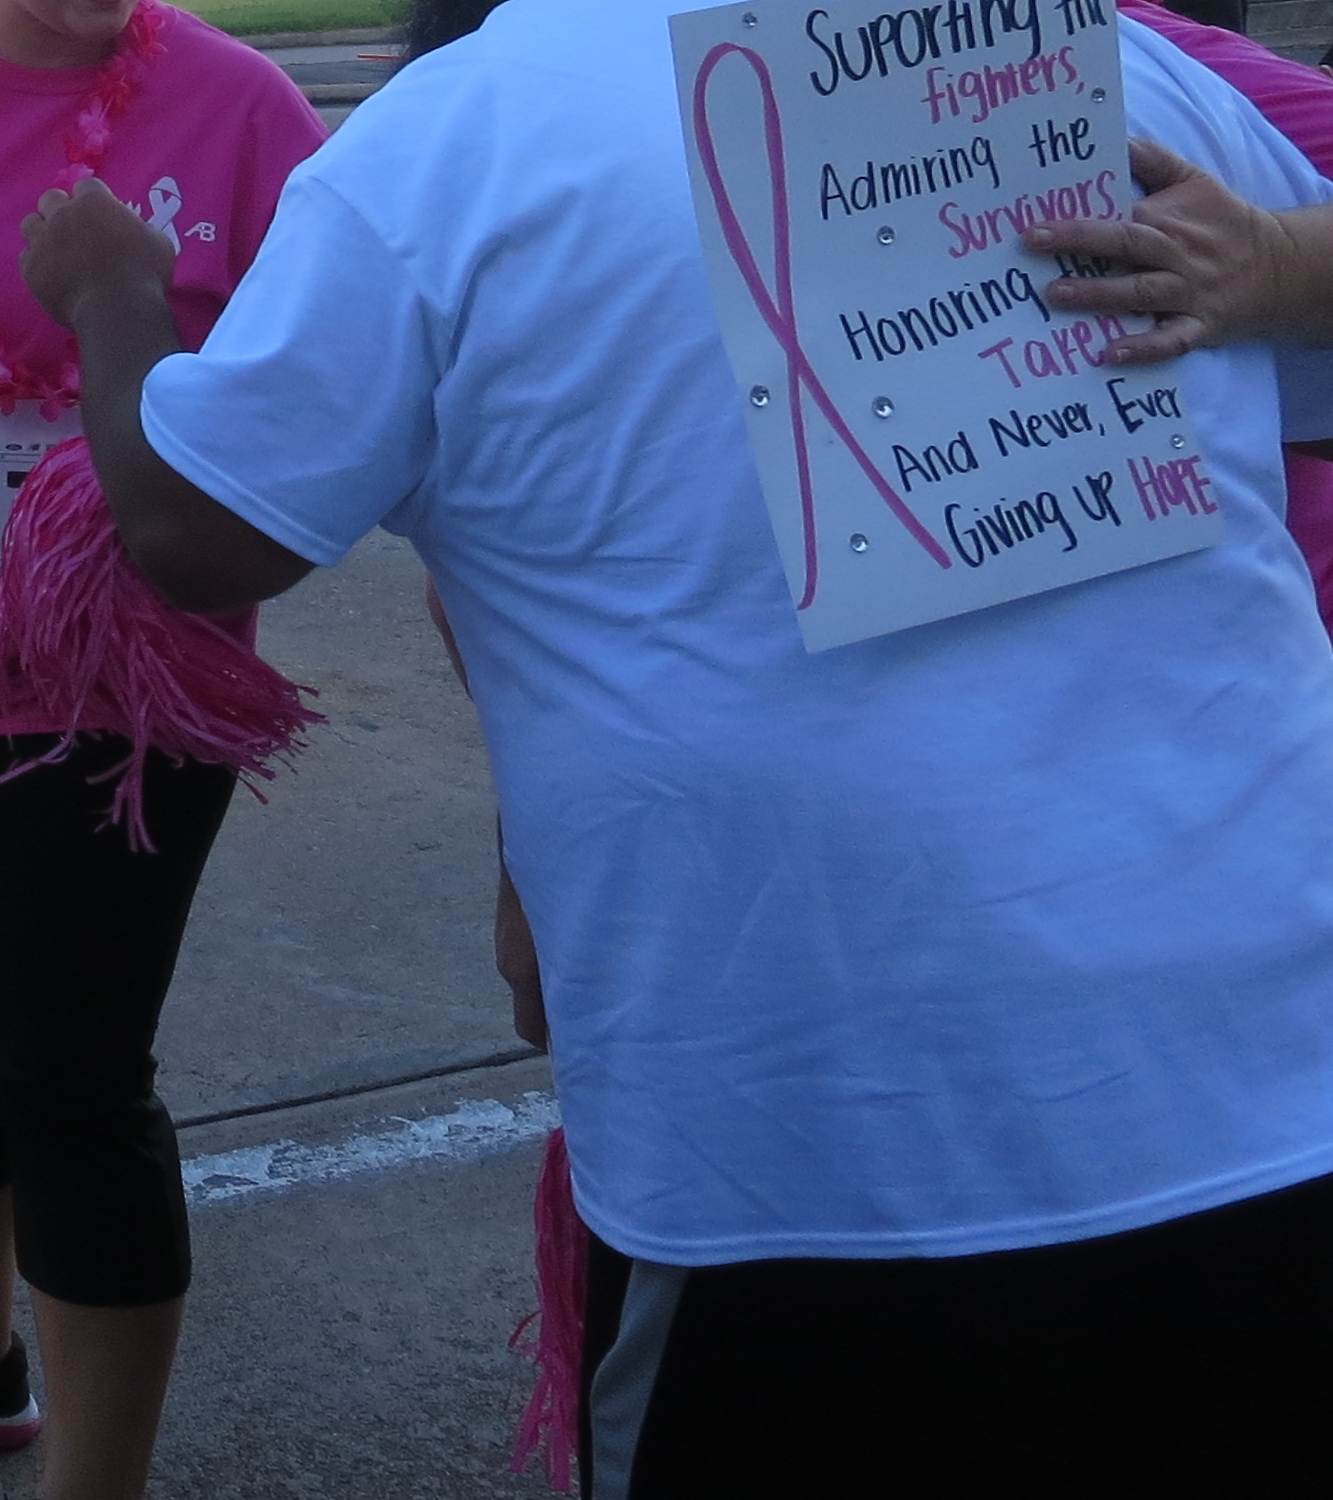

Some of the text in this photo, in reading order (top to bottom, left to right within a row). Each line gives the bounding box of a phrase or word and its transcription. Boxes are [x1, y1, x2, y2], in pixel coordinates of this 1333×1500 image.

[819, 117, 1096, 220] Admiring the
[839, 267, 1051, 361] Honoring
[977, 314, 1131, 388] Taken
[891, 377, 1183, 492] And Never, Ever
[944, 490, 1077, 568] Giving
